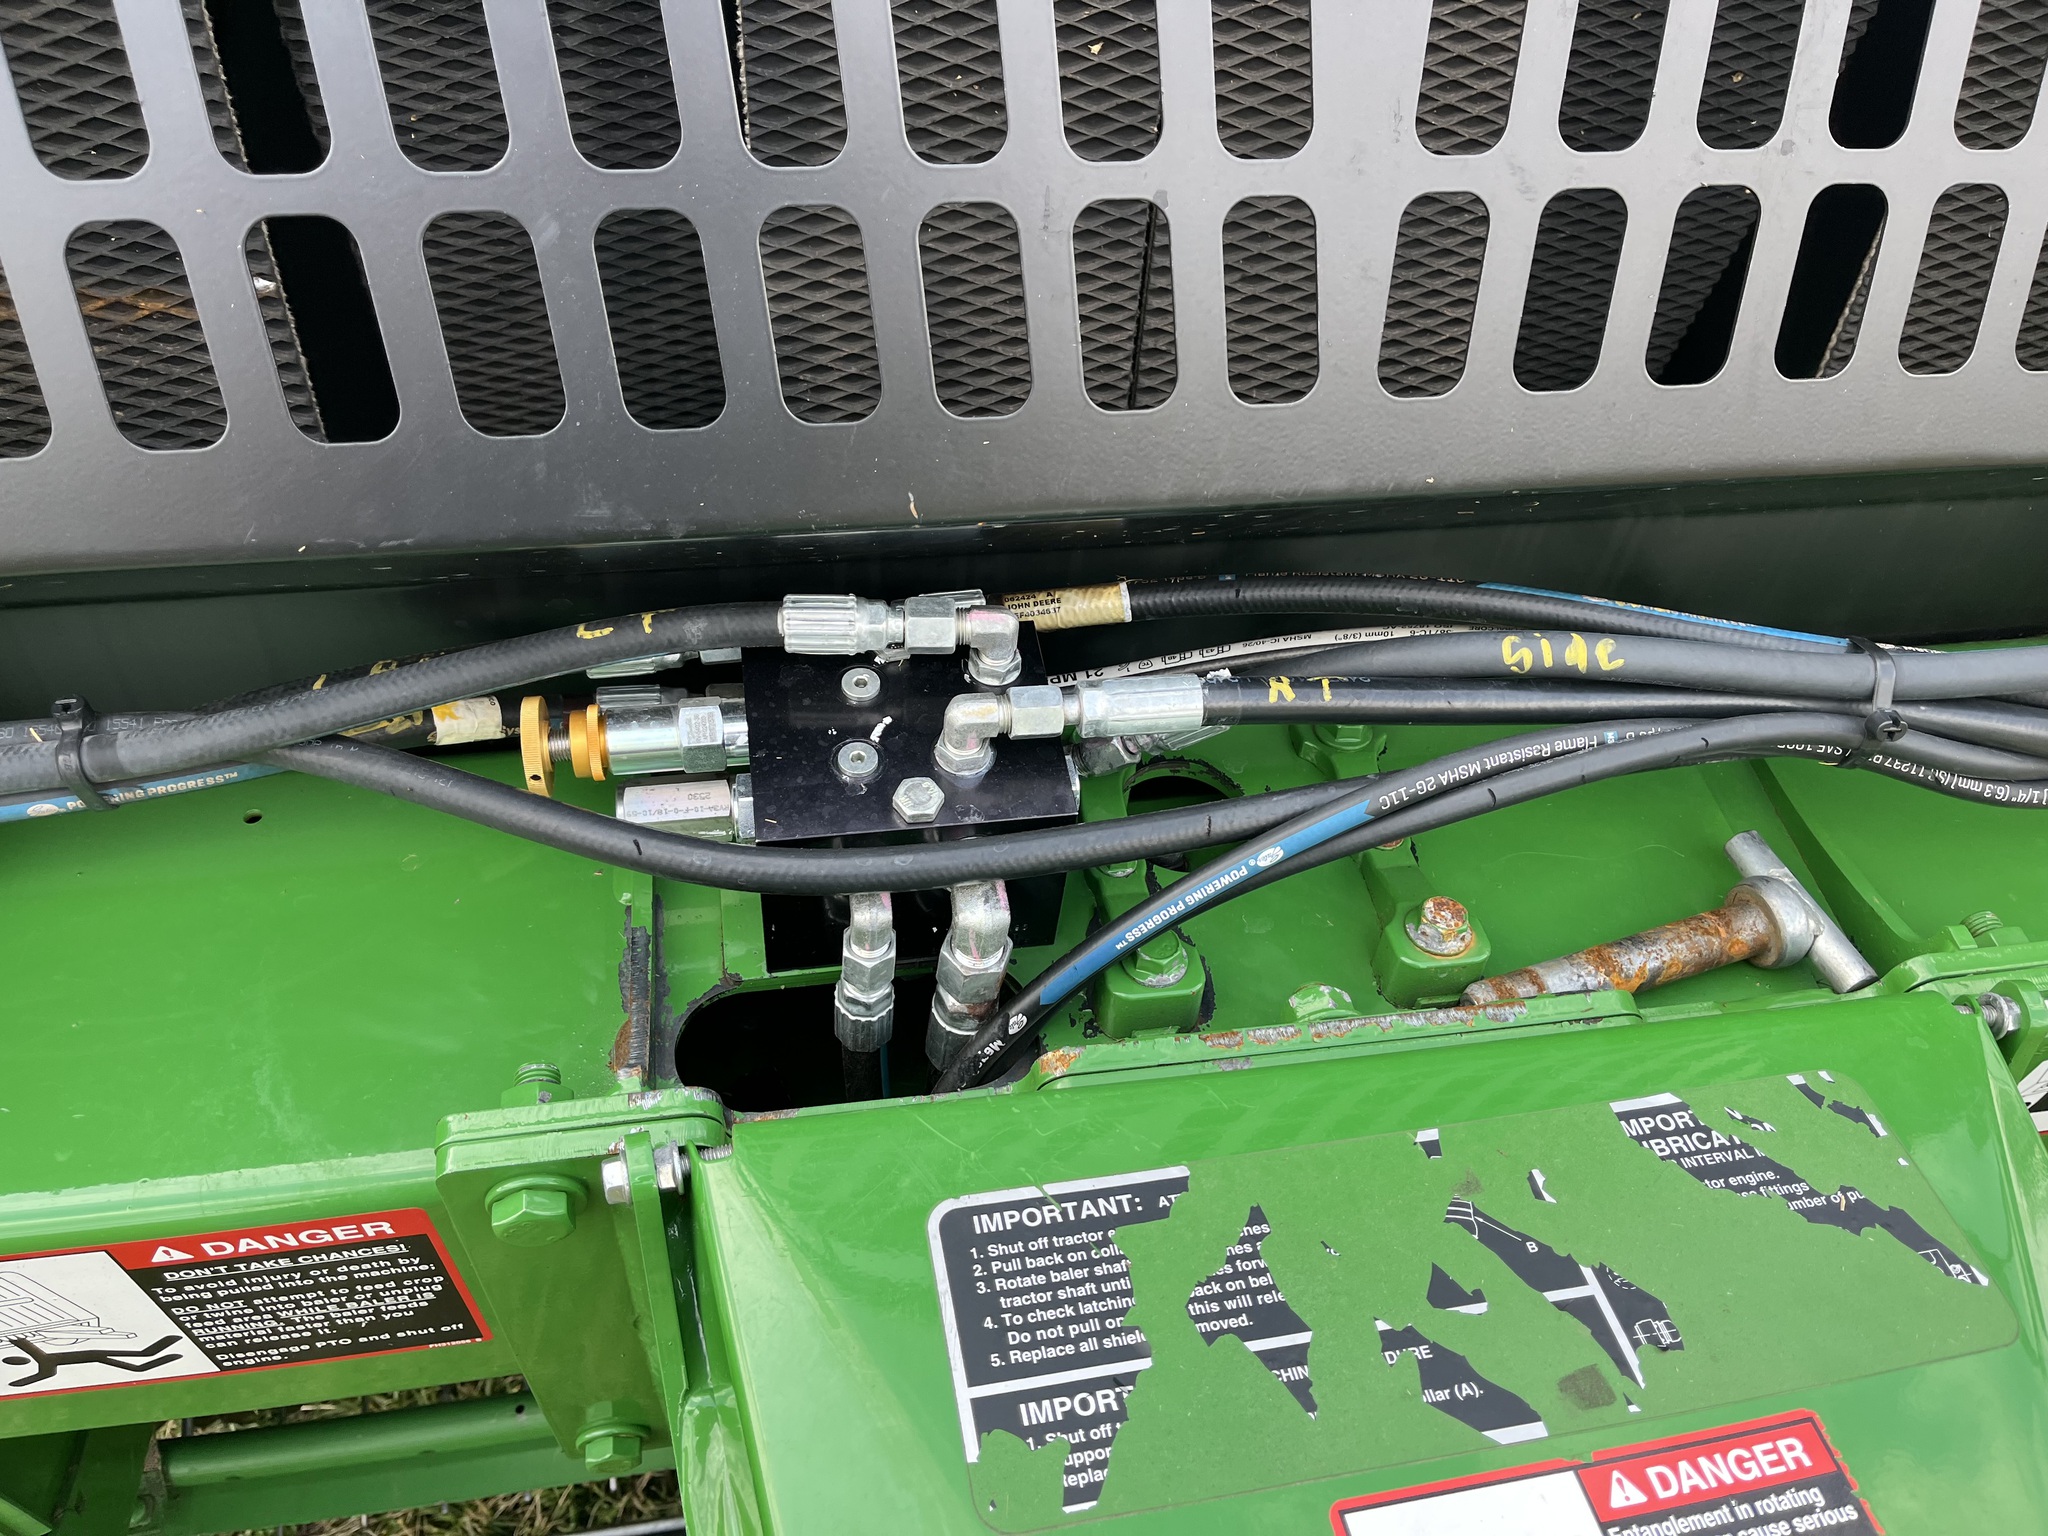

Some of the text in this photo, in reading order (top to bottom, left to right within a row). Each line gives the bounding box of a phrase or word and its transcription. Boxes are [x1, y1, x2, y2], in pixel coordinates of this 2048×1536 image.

[1033, 598, 1062, 607] DEERE
[1364, 630, 1395, 638] 10mm
[106, 716, 144, 731] 15541
[1378, 735, 1599, 811] Flame Resistant MSHA 2G-11C
[1184, 865, 1249, 907] POWERING
[1620, 1109, 1696, 1137] MPOR
[1680, 1148, 1755, 1169] INTERVAL
[1728, 1169, 1780, 1187] engine.
[972, 1194, 1143, 1235] IMPORTANT:
[200, 1221, 396, 1257] DANGER
[969, 1247, 984, 1260] 1.
[987, 1240, 1024, 1258] Shut
[1028, 1237, 1049, 1251] off
[1052, 1229, 1104, 1248] tractor
[1525, 1241, 1539, 1253] B
[163, 1243, 409, 1281] DON'T TAKE CHANCES!
[972, 1243, 1125, 1277] 2. Pull back on coll
[151, 1257, 421, 1295] To avoid injury or death by
[158, 1263, 436, 1303] being pulled into the machine;
[976, 1281, 991, 1295] 3.
[994, 1273, 1047, 1292] Rotate
[1049, 1265, 1090, 1283] baler
[1225, 1279, 1246, 1292] on
[171, 1275, 444, 1315] DO NOT attempt to feed crop
[178, 1283, 444, 1322] or twine into baler or unplug
[1000, 1290, 1053, 1309] tractor
[1057, 1282, 1099, 1300] shaft
[1188, 1300, 1221, 1316] this
[1223, 1294, 1253, 1311] will
[184, 1318, 226, 1329] feed
[232, 1313, 273, 1324] area
[276, 1304, 341, 1318] WHILE
[345, 1295, 411, 1309] BALER
[198, 1309, 415, 1343] material faster than you
[290, 1314, 325, 1323] The
[329, 1307, 375, 1319] baler
[379, 1300, 429, 1311] feeds
[983, 1316, 999, 1330] 4.
[1001, 1313, 1024, 1327] To
[1027, 1304, 1076, 1323] check
[1194, 1313, 1254, 1333] moved.
[205, 1340, 239, 1349] can
[244, 1330, 312, 1344] release
[216, 1323, 465, 1361] Disengage PTO and shut off
[1007, 1330, 1031, 1346] Do
[1036, 1324, 1065, 1341] not
[1069, 1317, 1101, 1338] pull
[220, 1355, 289, 1367] engine.
[990, 1353, 1006, 1367] 5.
[1009, 1344, 1076, 1364] Replace
[1080, 1337, 1099, 1352] all
[1454, 1381, 1484, 1401] (A).
[1089, 1422, 1112, 1440] off
[1646, 1436, 1813, 1500] DANGER
[1735, 1504, 1754, 1521] in
[1755, 1485, 1827, 1517] rotating
[1792, 1502, 1859, 1534] serious
